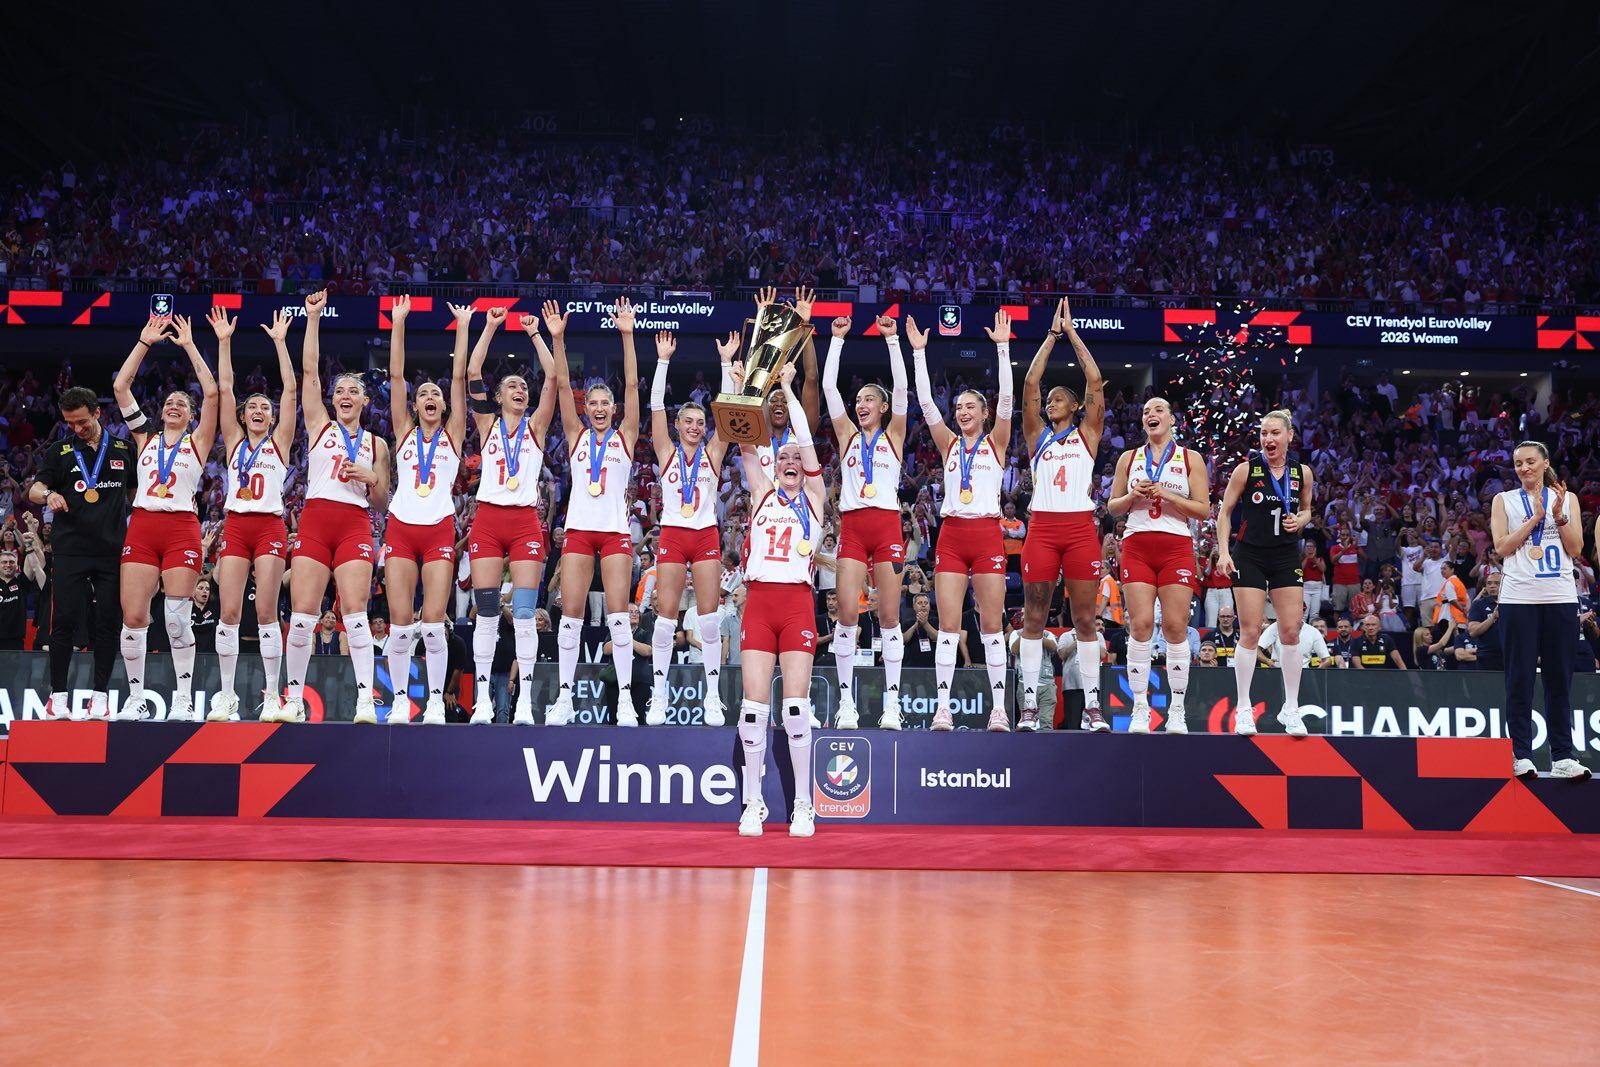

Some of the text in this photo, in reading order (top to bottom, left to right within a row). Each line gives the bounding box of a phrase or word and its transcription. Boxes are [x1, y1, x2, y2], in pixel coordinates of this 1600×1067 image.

[566, 302, 592, 313] CEV
[650, 303, 714, 317] EuroVolley
[633, 319, 679, 330] Women
[1072, 319, 1125, 330] STANBUL
[1346, 316, 1492, 331] CEV Trendyol EuroVolley
[1380, 332, 1458, 344] 2026 Women
[146, 470, 177, 499] 22
[1053, 465, 1067, 492] 4
[1270, 507, 1282, 536] 1
[765, 525, 792, 557] 14
[1123, 569, 1129, 578] 3
[571, 680, 605, 699] EV
[665, 707, 704, 725] 202
[830, 742, 854, 751] CEV
[920, 767, 1011, 788] Istanbul
[823, 782, 861, 796] EuroVolley 2026
[819, 802, 865, 815] trendyol
